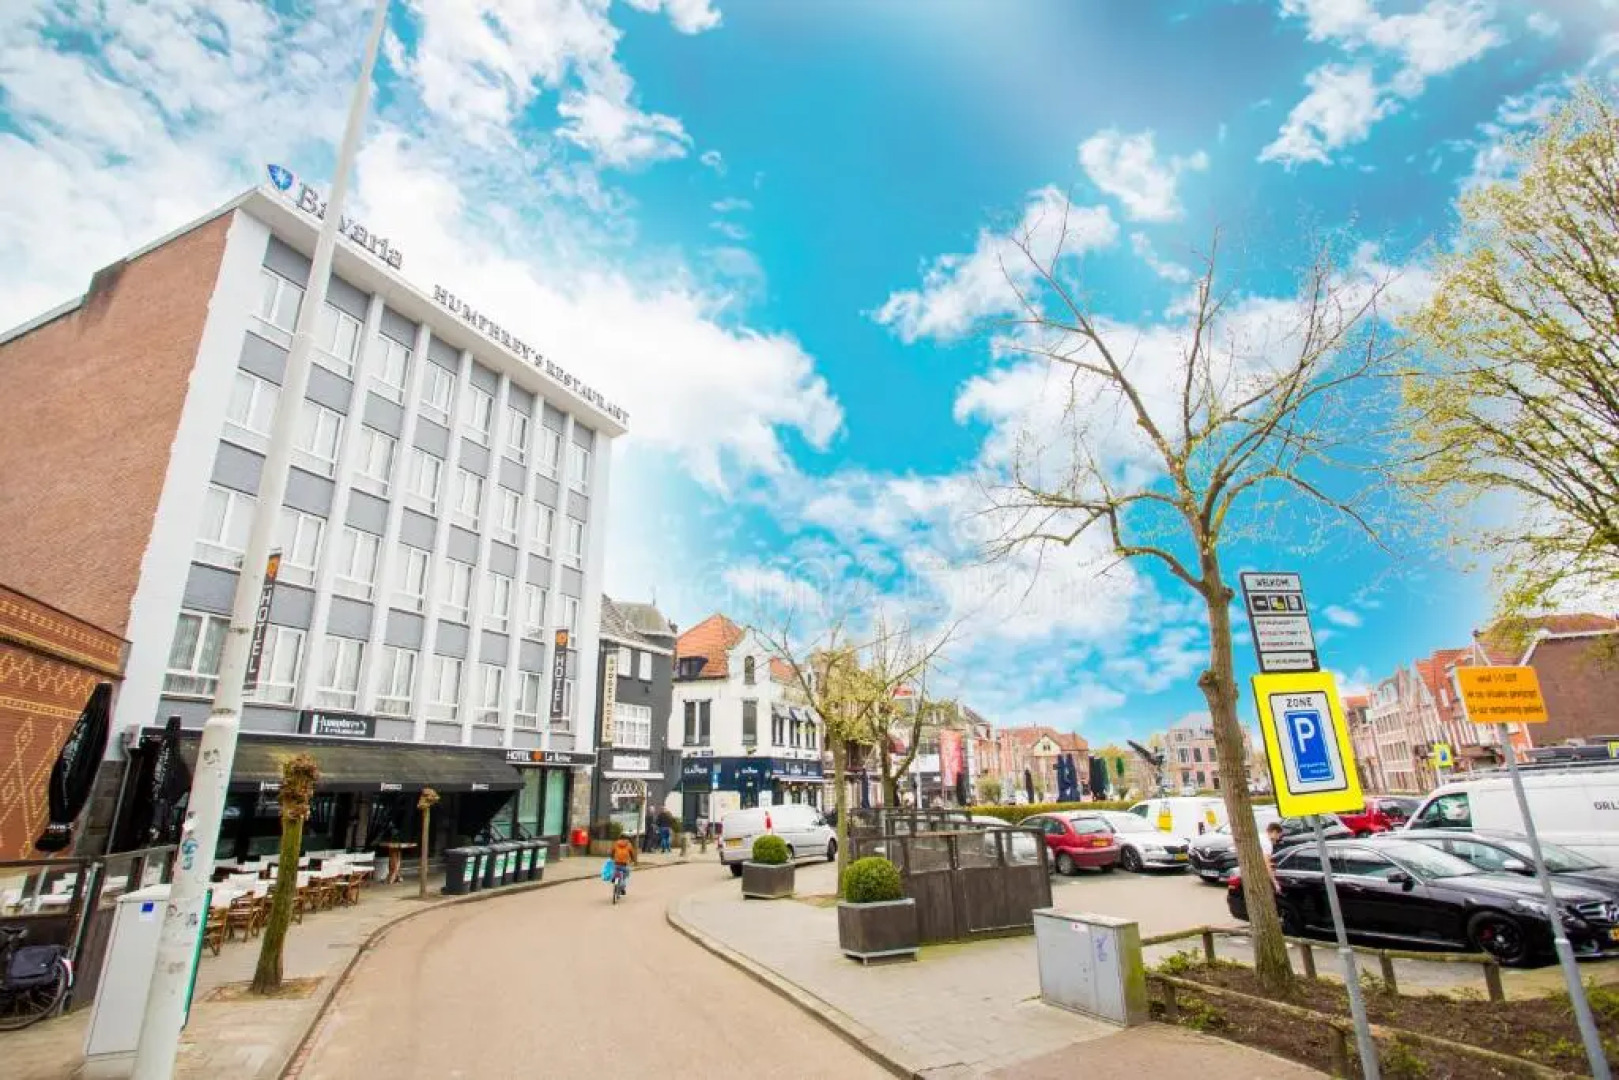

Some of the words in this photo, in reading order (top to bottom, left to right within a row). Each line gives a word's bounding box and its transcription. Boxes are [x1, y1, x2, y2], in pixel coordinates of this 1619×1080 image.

[296, 183, 402, 270] Bavaria
[434, 284, 544, 367] HUMPHREY'S
[546, 357, 630, 425] RESTAURANT
[248, 588, 273, 673] HOTEL
[553, 655, 564, 713] HOTEL
[1286, 697, 1312, 708] ZONE
[505, 750, 531, 761] HOTEL
[1294, 717, 1315, 753] P
